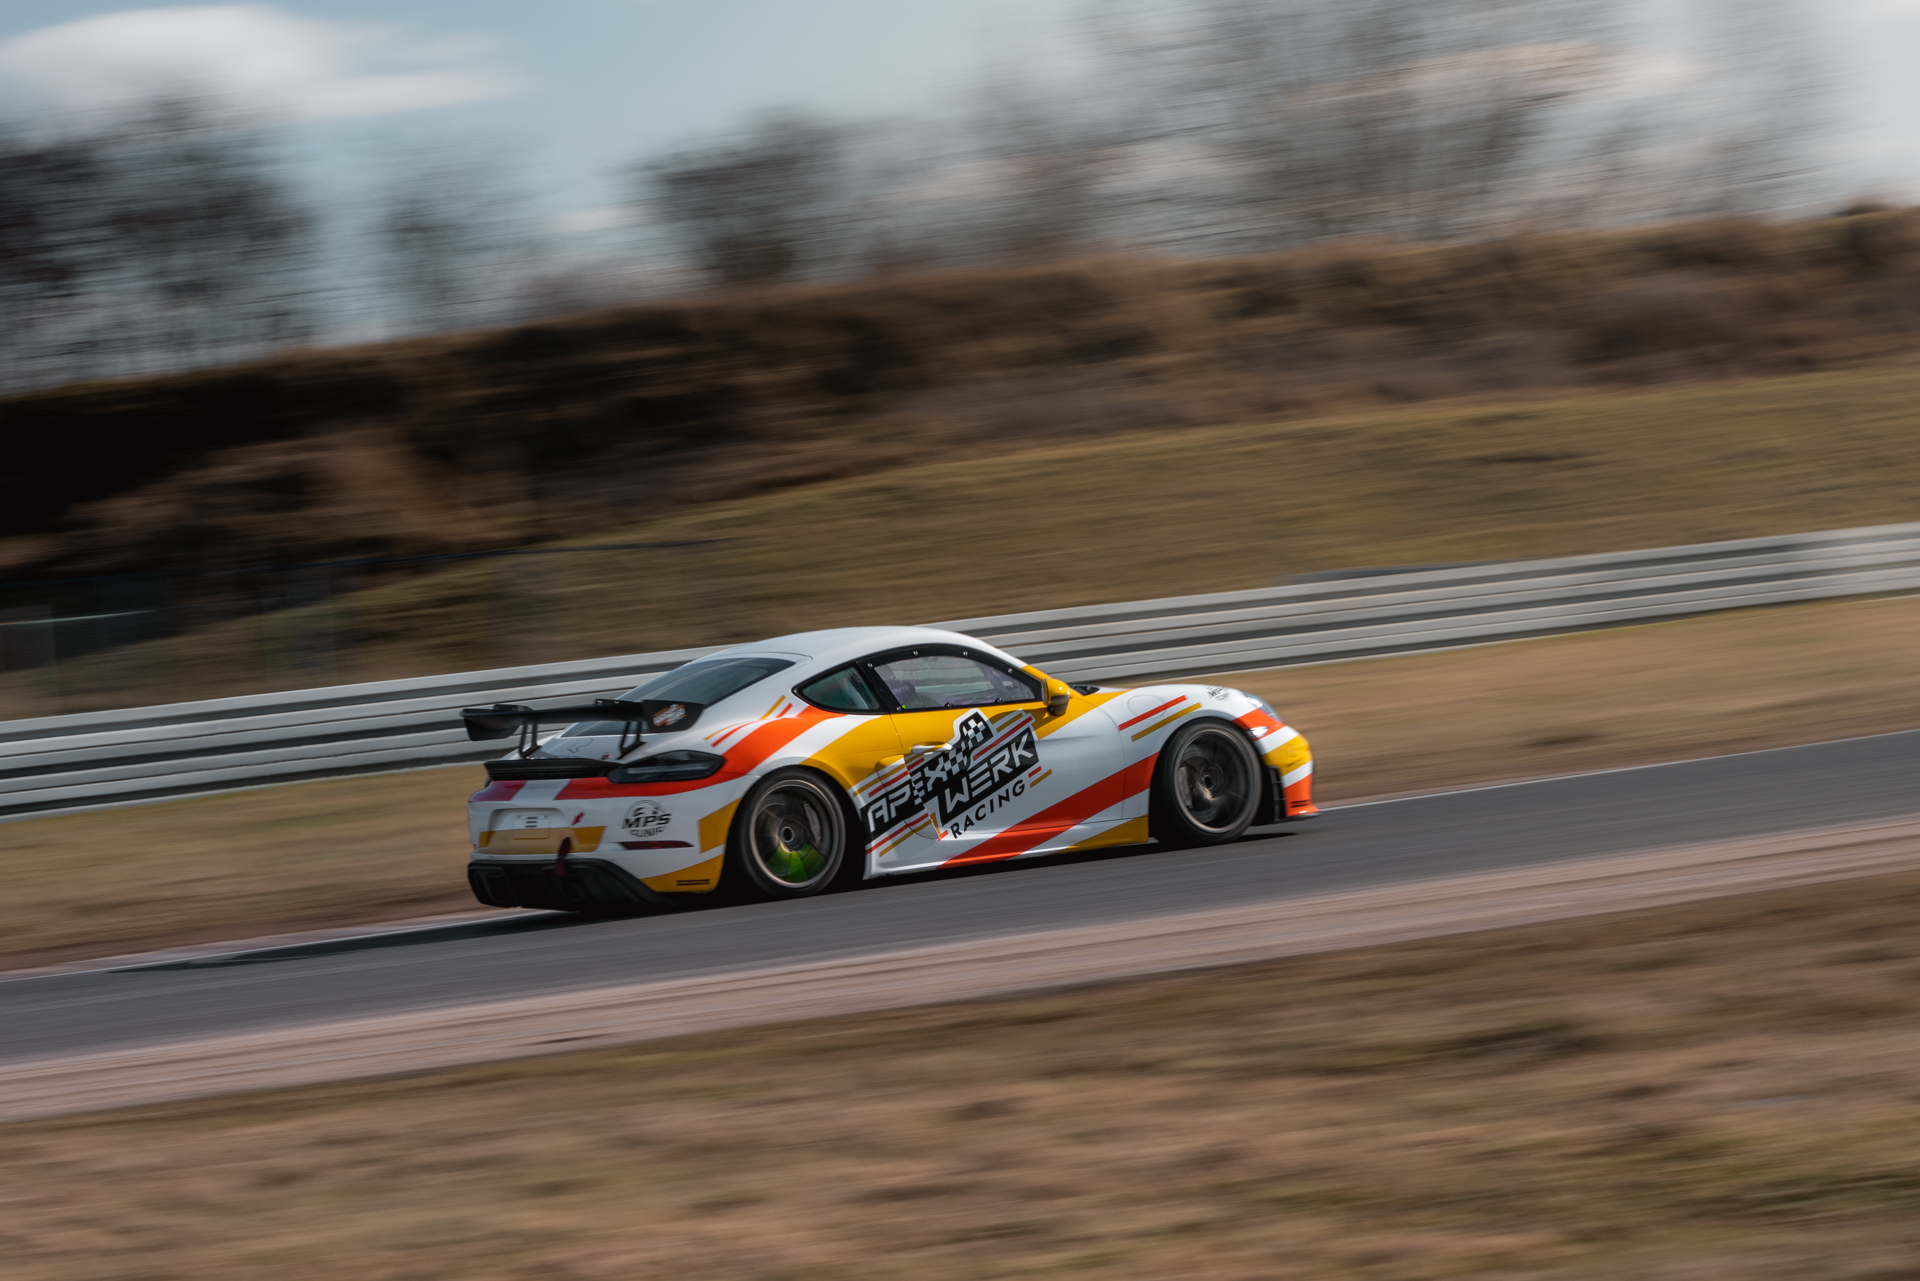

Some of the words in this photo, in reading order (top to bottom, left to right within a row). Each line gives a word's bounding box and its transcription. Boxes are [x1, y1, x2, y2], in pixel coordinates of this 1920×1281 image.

[867, 756, 948, 832] APEX
[945, 732, 1034, 815] WERK
[621, 813, 673, 830] MPS
[629, 826, 666, 838] CLINIC
[950, 779, 1026, 839] RACING
